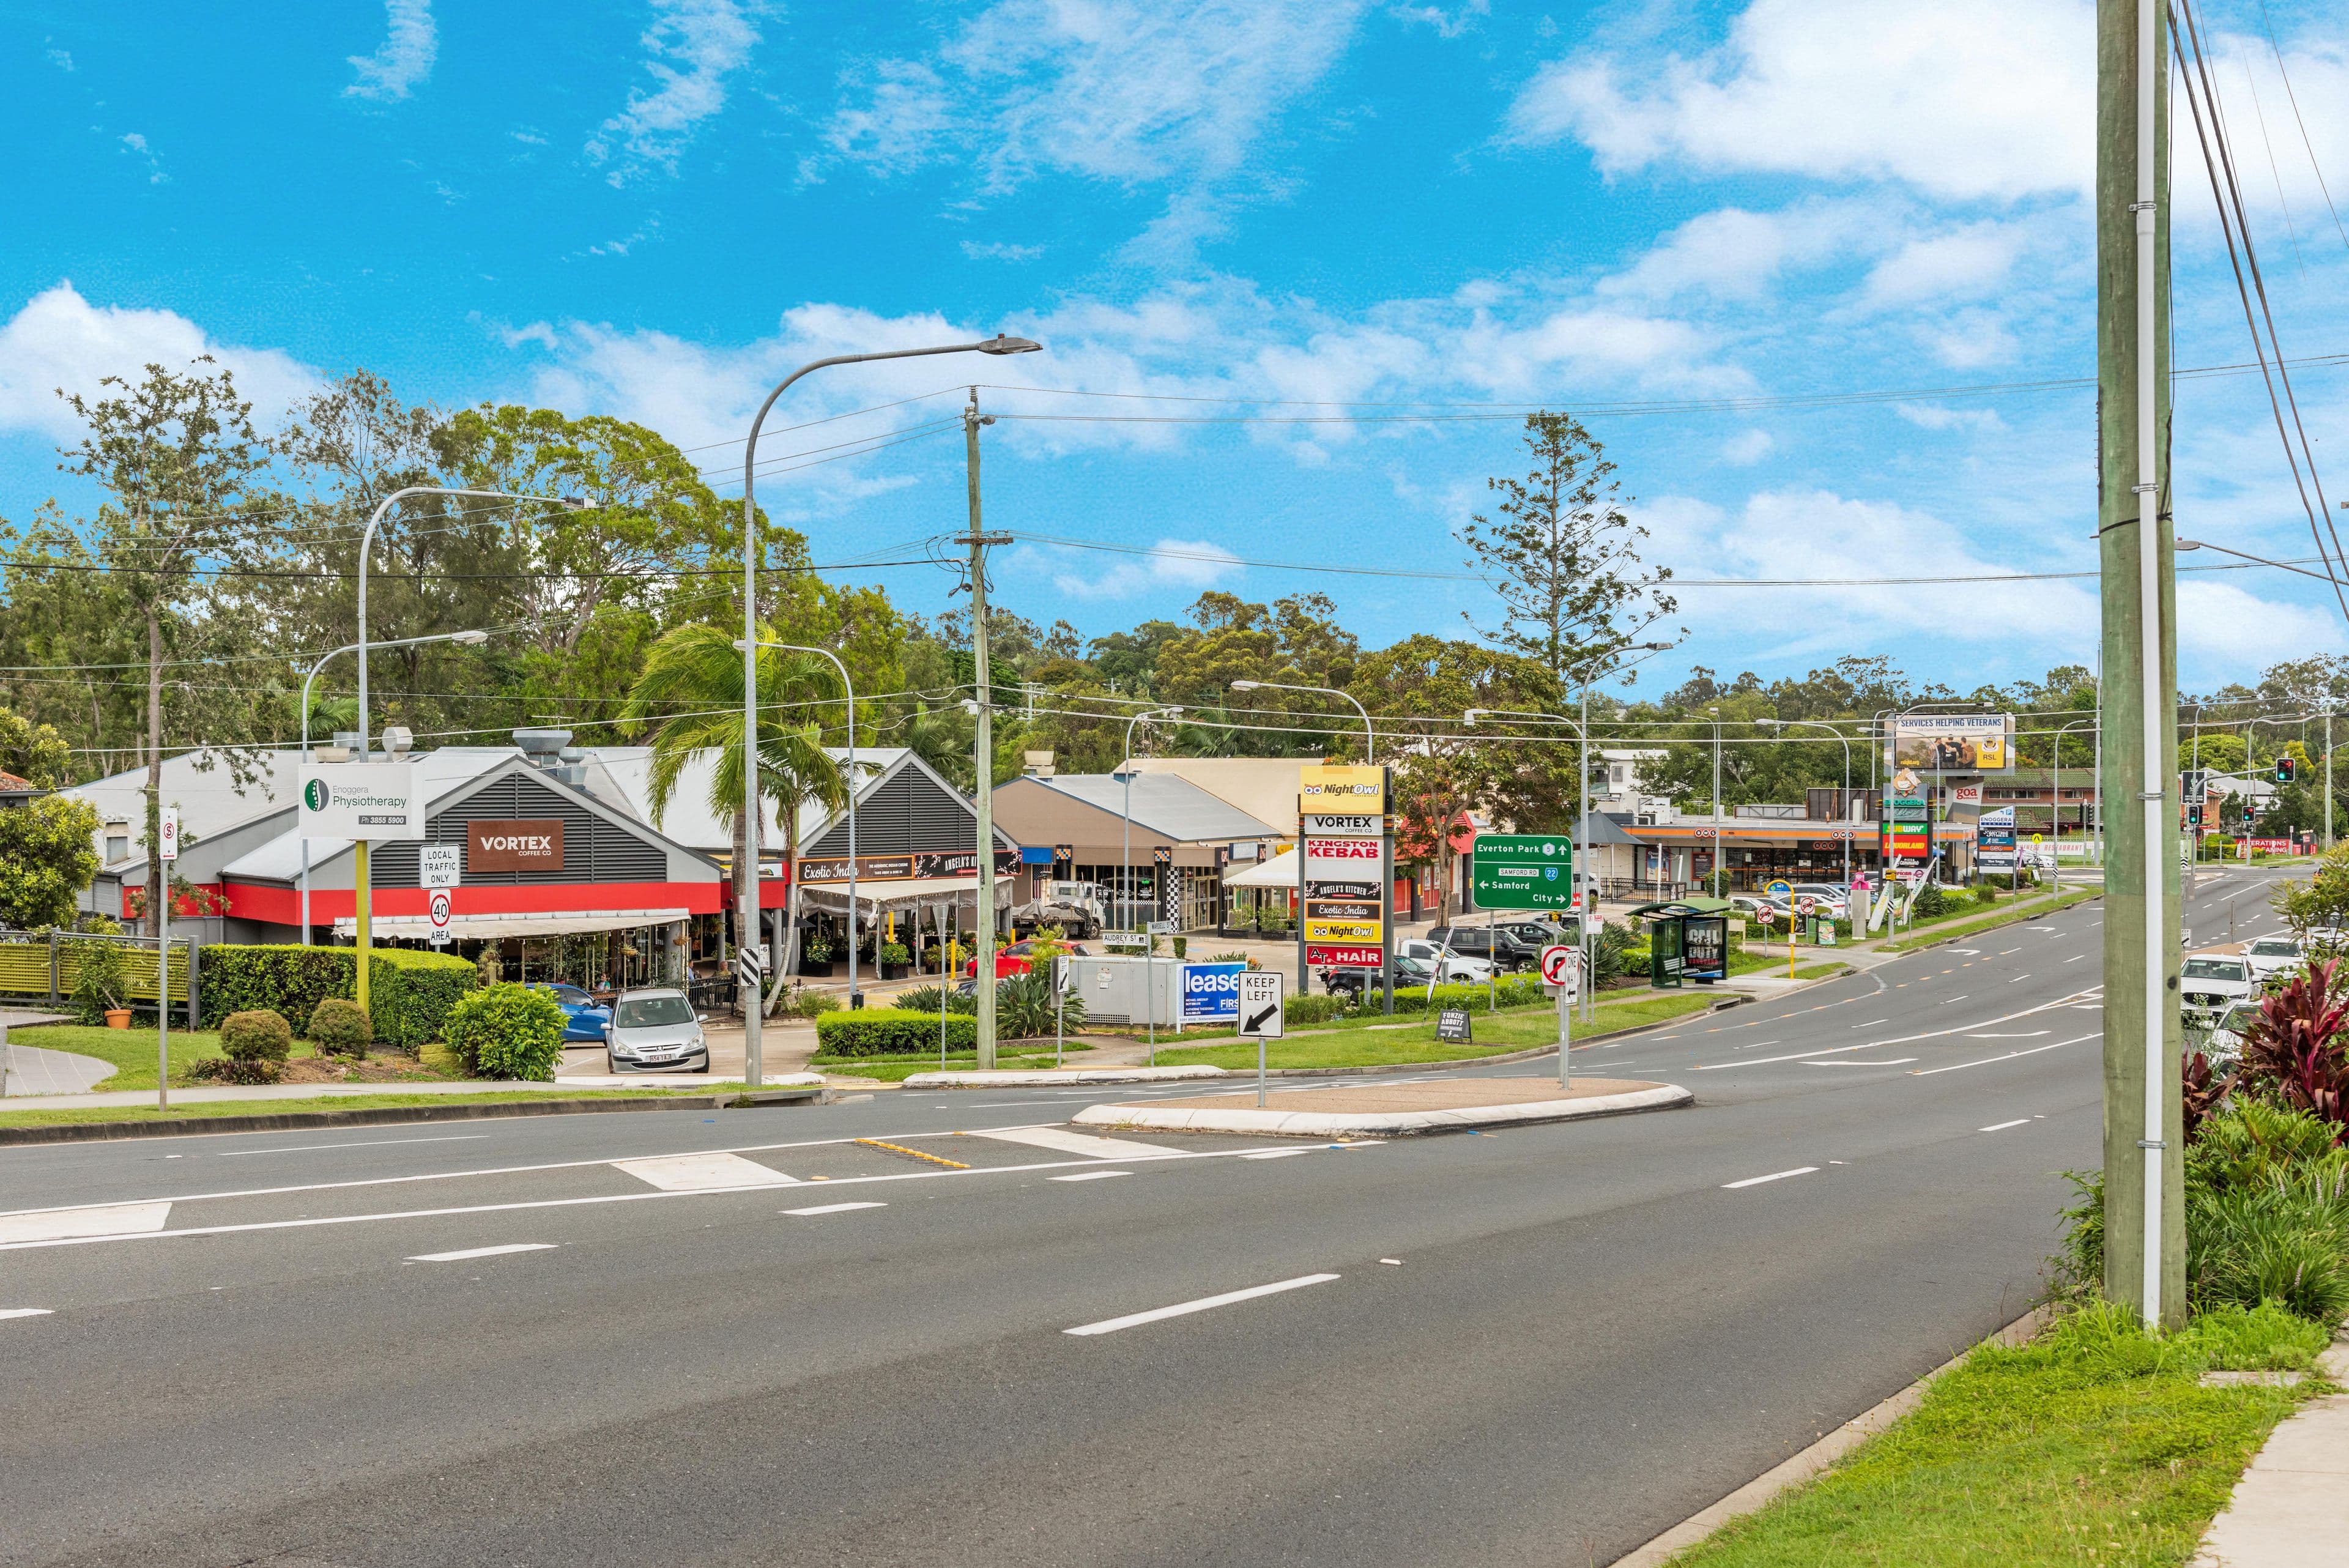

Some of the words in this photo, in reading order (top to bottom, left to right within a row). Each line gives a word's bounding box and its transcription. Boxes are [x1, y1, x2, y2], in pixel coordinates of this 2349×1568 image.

[1901, 718, 1933, 727] SERVICES
[1936, 718, 1964, 727] HELPING
[1967, 718, 2002, 727] VETERANS
[333, 786, 369, 795] Enoggera
[1324, 784, 1379, 796] NightOwl
[1956, 788, 1977, 800] goa
[333, 796, 407, 809] Physiotherapy
[1315, 817, 1372, 827] VORTEX
[480, 836, 551, 850] VORTEX
[428, 850, 452, 859] LOCAL
[1308, 847, 1378, 858] KEBAB
[425, 862, 456, 871] TRAFFIC
[945, 857, 969, 871] ANGELA'S
[804, 864, 832, 879] Exotic
[833, 863, 859, 877] Inda
[431, 874, 450, 883] ONLY
[1320, 885, 1343, 894] ANGELA'S
[1345, 886, 1367, 896] KITCHEN
[1533, 894, 1552, 904] City
[434, 903, 447, 918] 40
[1319, 904, 1343, 914] Exotic
[1344, 905, 1368, 915] India
[431, 931, 450, 940] AREA
[1329, 926, 1373, 937] NightOwl
[1689, 929, 1719, 944] CALL
[1186, 970, 1238, 992] lease
[1247, 977, 1275, 987] KEEP
[1567, 973, 1576, 984] WAY
[1247, 991, 1274, 1001] LEFT
[1220, 998, 1238, 1008] FIRS
